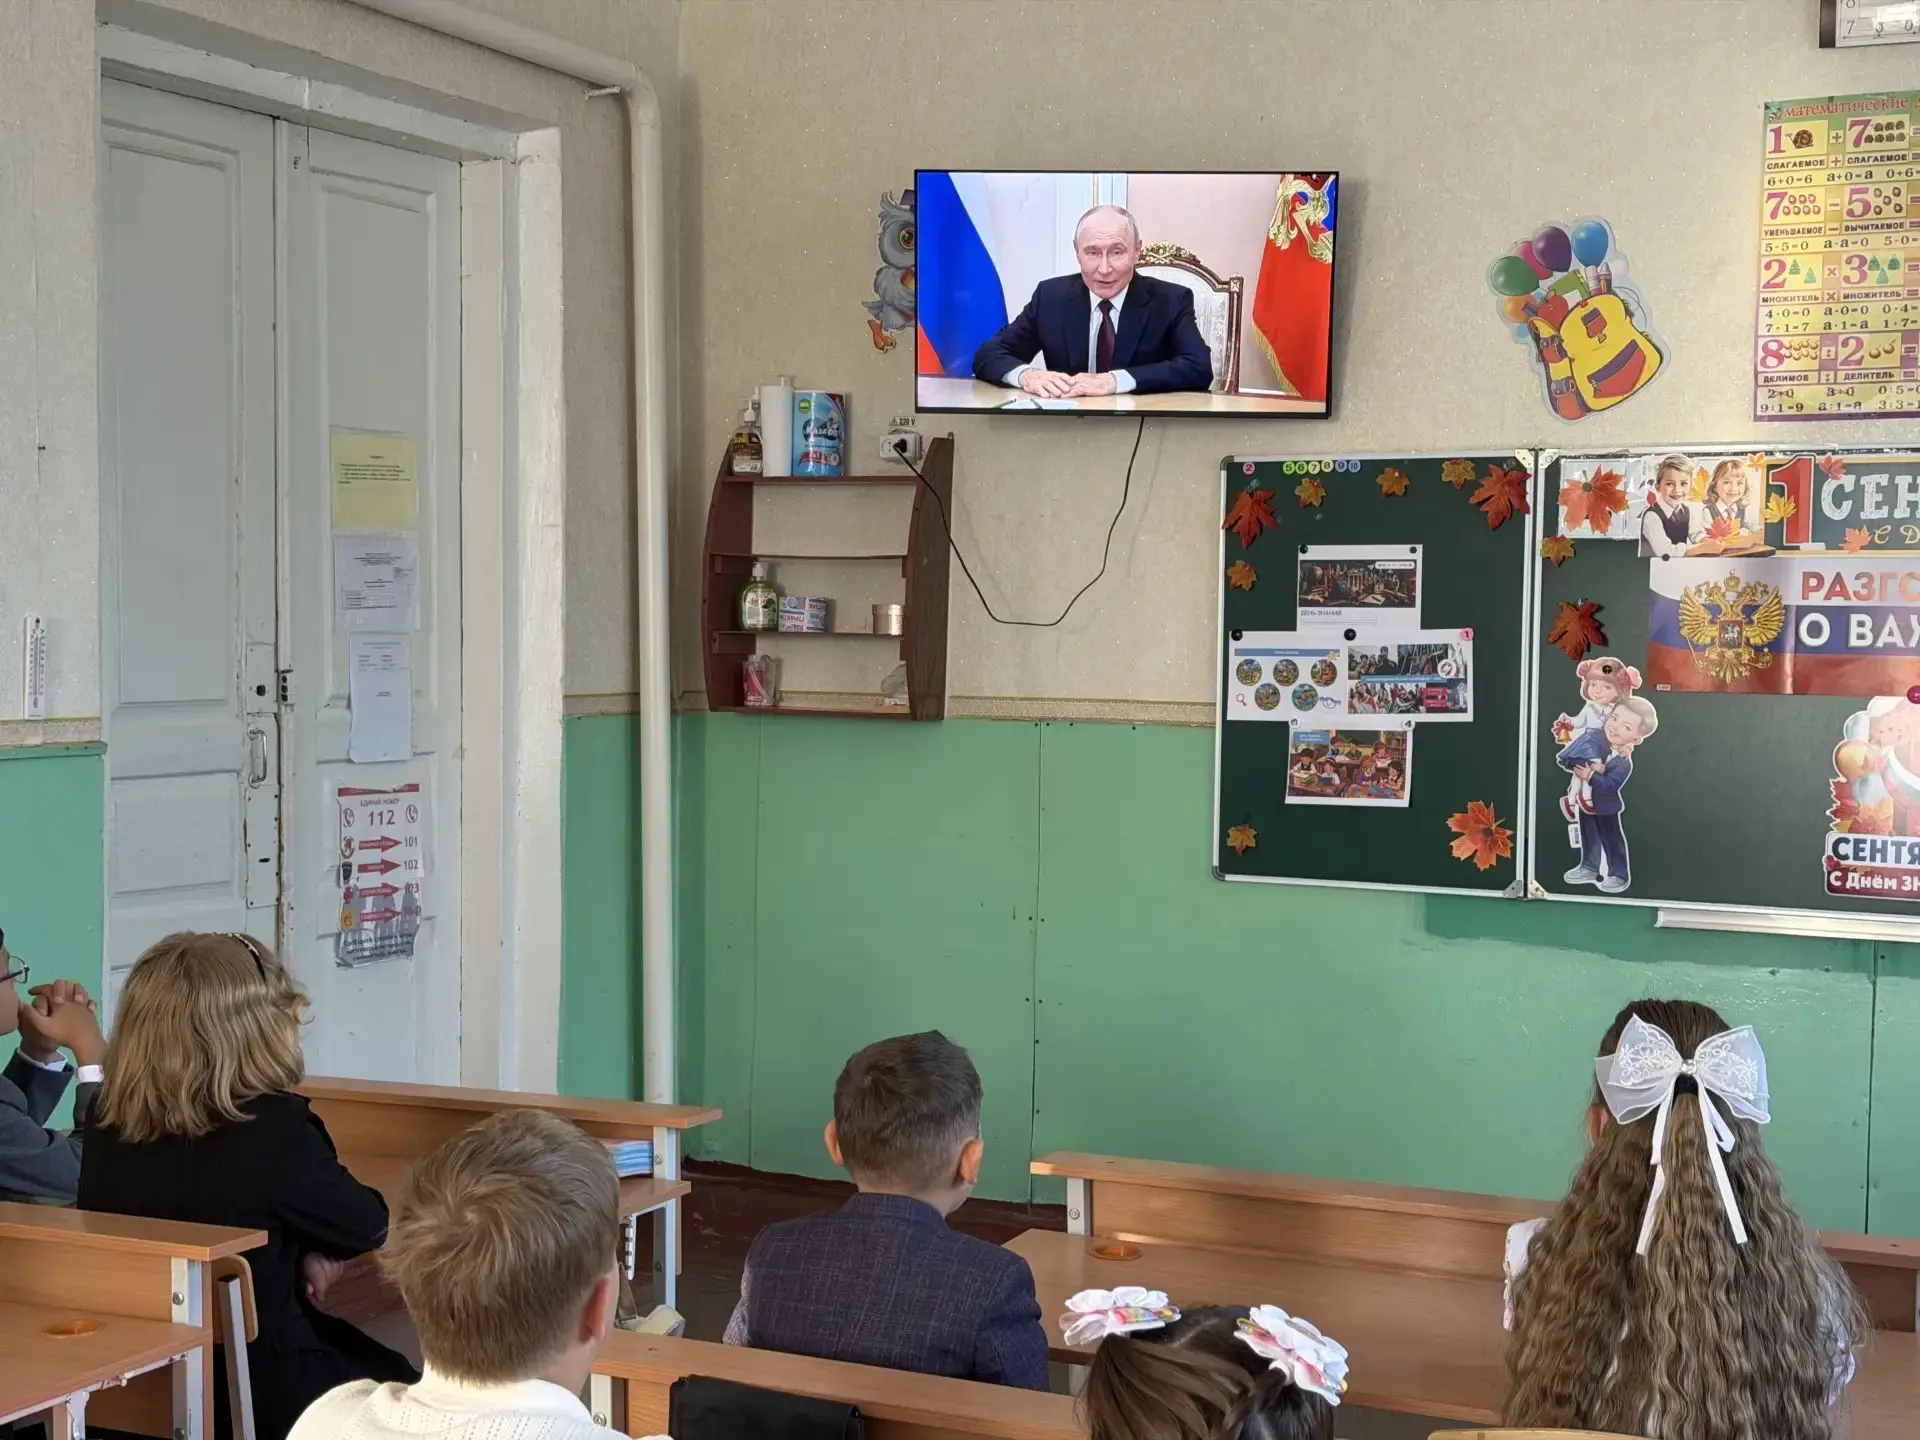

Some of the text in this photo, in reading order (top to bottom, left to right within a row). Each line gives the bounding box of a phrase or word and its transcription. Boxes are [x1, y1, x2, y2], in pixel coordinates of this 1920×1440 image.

[1846, 20, 1856, 35] 7
[1768, 126, 1786, 154] 1
[1848, 118, 1872, 148] 7
[1766, 159, 1826, 170] СЛАГАЕМОЕ
[1847, 153, 1908, 165] СЛАГАЕМОЕ
[1765, 191, 1789, 220] 7
[1845, 187, 1872, 218] 5
[1764, 226, 1823, 237] УМЕНЬШАЕМОЕ
[1844, 221, 1905, 232] ВЫЧИТАЕМОЕ
[1762, 258, 1787, 289] 2
[1842, 254, 1868, 285] 3
[1762, 294, 1820, 304] МНОЖИТЕЛЬ
[1842, 289, 1902, 300] МНОЖИТЕЛЬ
[1759, 338, 1785, 369] 8
[1838, 335, 1865, 367] 2
[1763, 374, 1809, 384] ДЕЛИМОЕ
[1843, 371, 1895, 381] ДЕЛИТЕЛЬ
[899, 417, 910, 426] 220
[1770, 453, 1816, 547] 1
[1799, 612, 1831, 648] О
[368, 809, 396, 827] 112
[404, 835, 418, 848] 101
[403, 859, 419, 871] 102
[404, 881, 420, 894] 103
[1845, 872, 1897, 890] Днём
